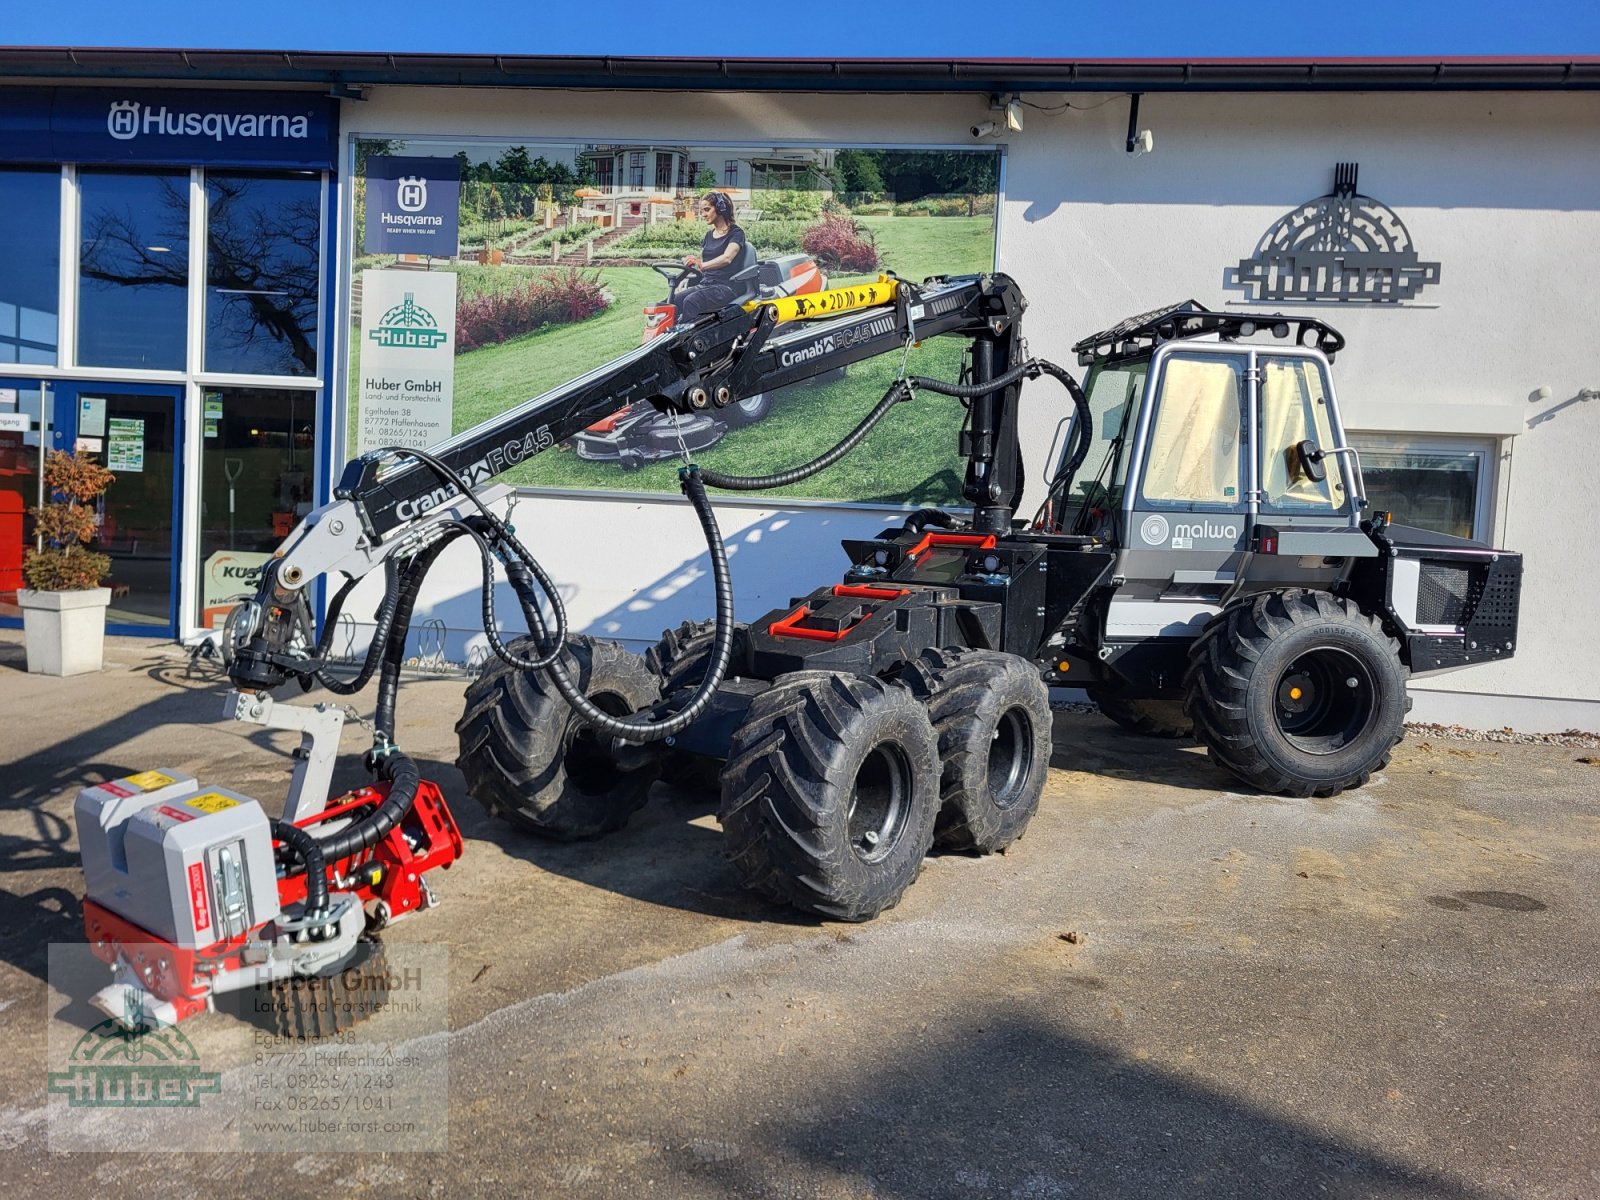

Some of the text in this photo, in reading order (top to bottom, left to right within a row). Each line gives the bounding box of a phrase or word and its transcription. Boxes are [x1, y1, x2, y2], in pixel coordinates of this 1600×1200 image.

[143, 106, 308, 142] Husqvarna
[381, 212, 443, 226] Husqvarna
[829, 290, 857, 311] 20 M
[370, 329, 446, 347] Huber
[781, 323, 871, 367] Cranab FC45
[366, 377, 442, 393] Huber GmbH
[365, 391, 442, 403] Land- und Forsttechnik
[364, 406, 412, 417] Egelhofen 38
[364, 417, 440, 428] 87772 Pfaffenhausen
[363, 427, 428, 438] Tel. 08265/1243
[363, 437, 427, 448] Fax 08265/1041
[486, 424, 554, 475] FC45
[1174, 519, 1237, 539] malwa
